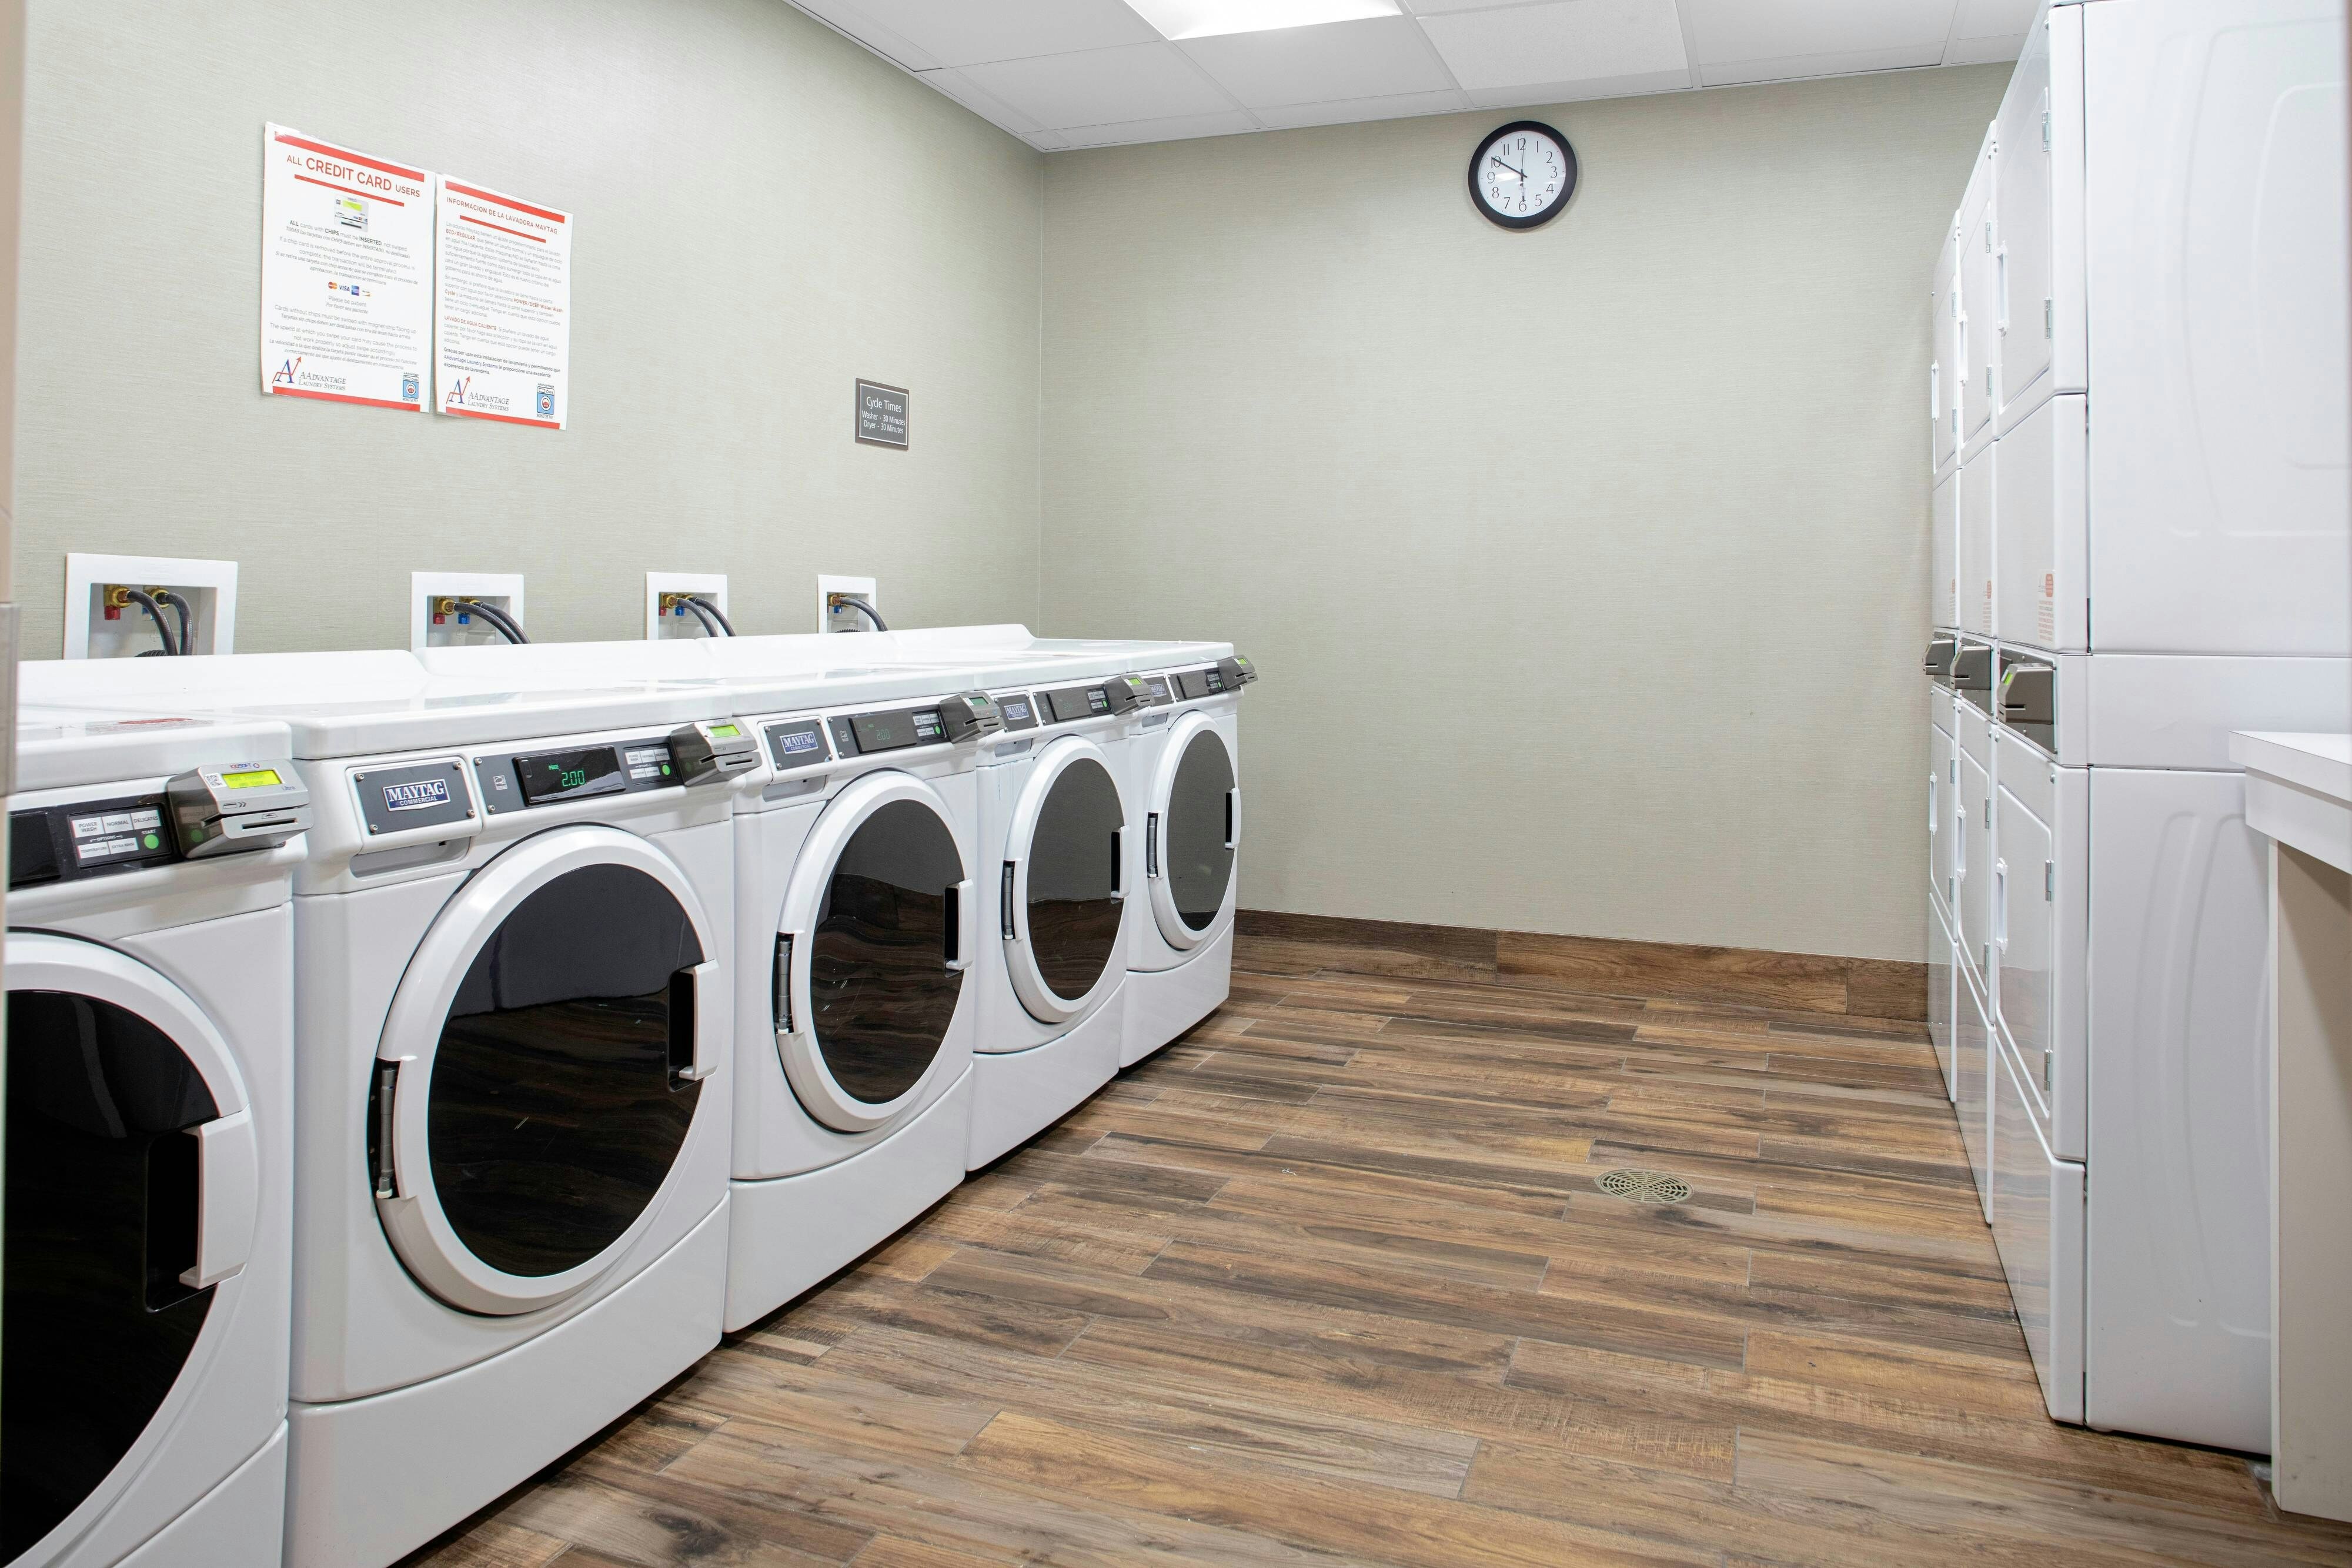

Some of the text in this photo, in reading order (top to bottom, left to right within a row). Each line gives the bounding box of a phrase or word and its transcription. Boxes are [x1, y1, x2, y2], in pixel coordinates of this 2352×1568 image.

[1503, 143, 1509, 155] 11
[1517, 138, 1526, 151] 12
[1491, 156, 1501, 168] 10
[1545, 151, 1553, 163] 2
[286, 154, 420, 198] ALL CREDIT CARD USERS
[1487, 172, 1495, 183] 9
[1551, 166, 1558, 178] 3
[1492, 186, 1499, 198] 8
[1546, 183, 1554, 194] 4
[1504, 197, 1511, 209] 7
[1519, 199, 1527, 212] 6
[1535, 194, 1542, 206] 5
[446, 196, 487, 214] INFORMACION
[506, 213, 533, 227] LAVADORA
[535, 222, 557, 234] MAYTAG
[325, 228, 339, 236] CHIPS
[445, 289, 455, 297] Cycle
[513, 297, 539, 308] POWER/DEEP
[444, 315, 460, 323] LAVADO
[280, 323, 295, 333] speed
[466, 359, 481, 367] Laundry
[482, 362, 498, 370] Systems
[298, 379, 346, 391] LAUNDRY SYSTEMS
[467, 399, 509, 412] LAUNDRY SYSTEMS
[866, 396, 902, 412] Cycle Times
[861, 410, 878, 420] Washer
[883, 414, 888, 423] 30
[889, 416, 906, 426] Minutes
[864, 420, 876, 430] Dryer
[887, 424, 904, 434] Minutes
[1006, 705, 1026, 714] MAYTAG
[783, 734, 814, 747] MAYTAG
[562, 770, 585, 787] 2.00
[386, 782, 445, 801] MAYTAG
[400, 796, 438, 806] COMMERCIAL
